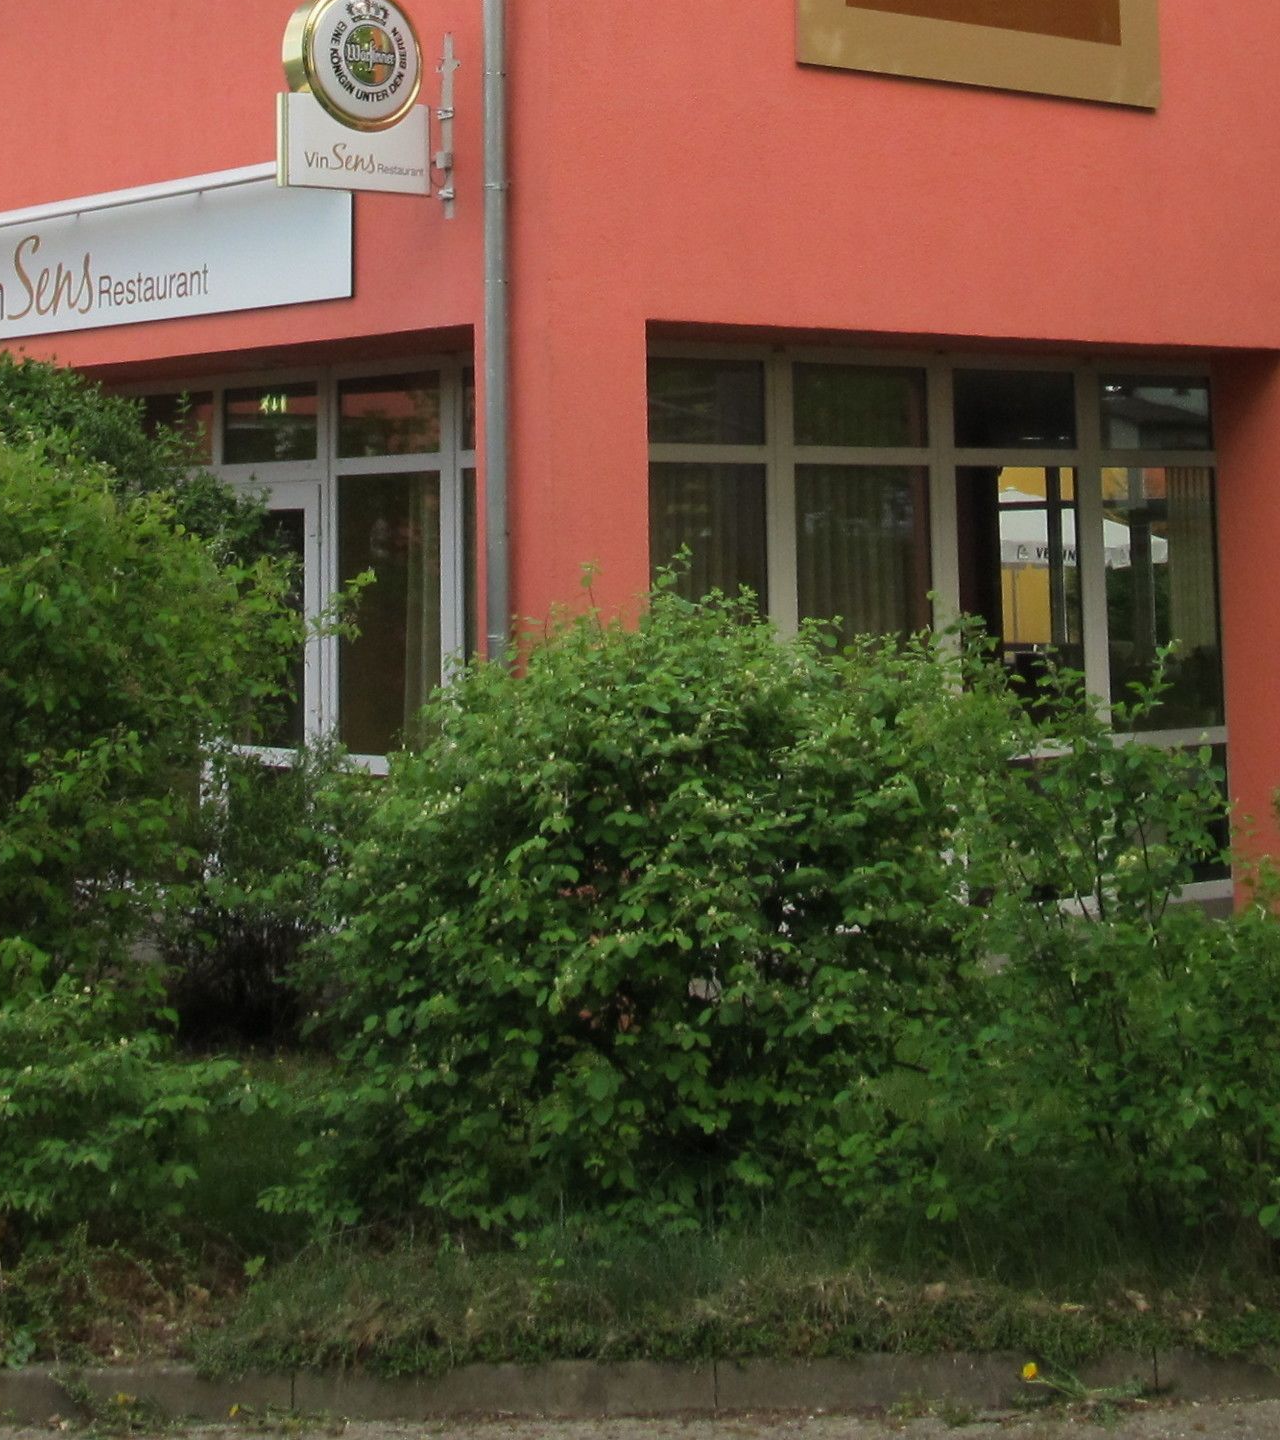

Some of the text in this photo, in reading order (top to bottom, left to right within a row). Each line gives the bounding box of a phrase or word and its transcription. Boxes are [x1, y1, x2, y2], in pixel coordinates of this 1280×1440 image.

[330, 21, 407, 102] EINE KÖNIGIN UNTER DEN BIEREN
[378, 163, 424, 176] Restaurant
[98, 264, 209, 309] Restaurant
